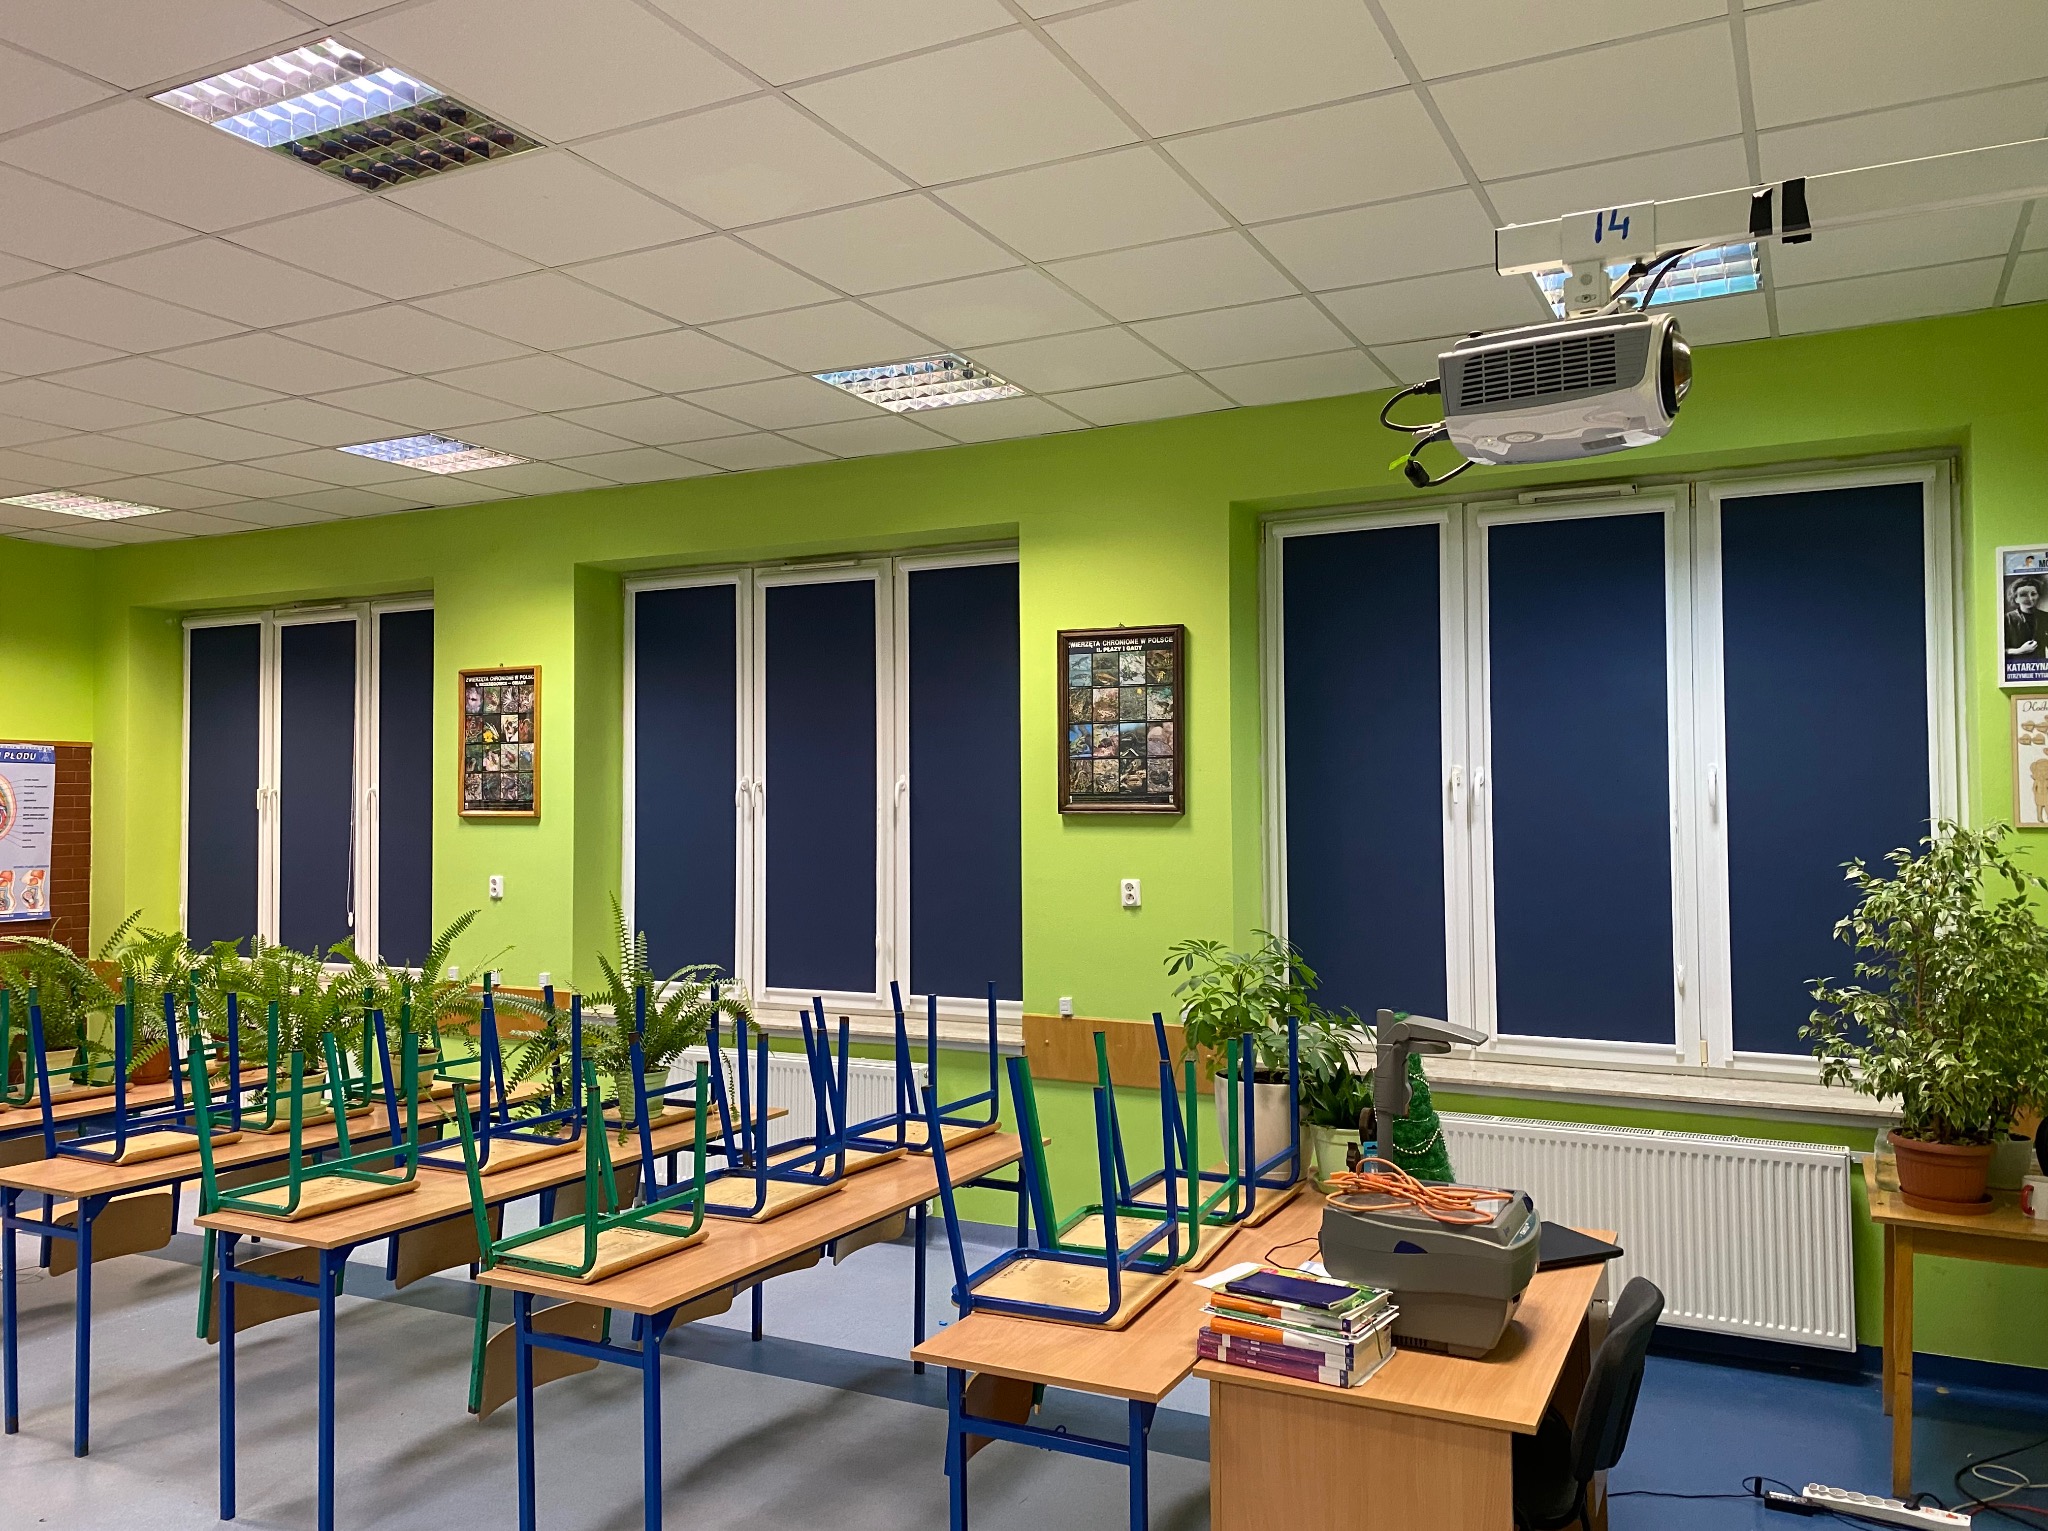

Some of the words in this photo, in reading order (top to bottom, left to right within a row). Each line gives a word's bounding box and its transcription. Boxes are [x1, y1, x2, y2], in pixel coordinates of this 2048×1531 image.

[1594, 208, 1629, 243] 14
[1102, 638, 1138, 646] CHRONIONE
[4, 751, 37, 761] PŁODU
